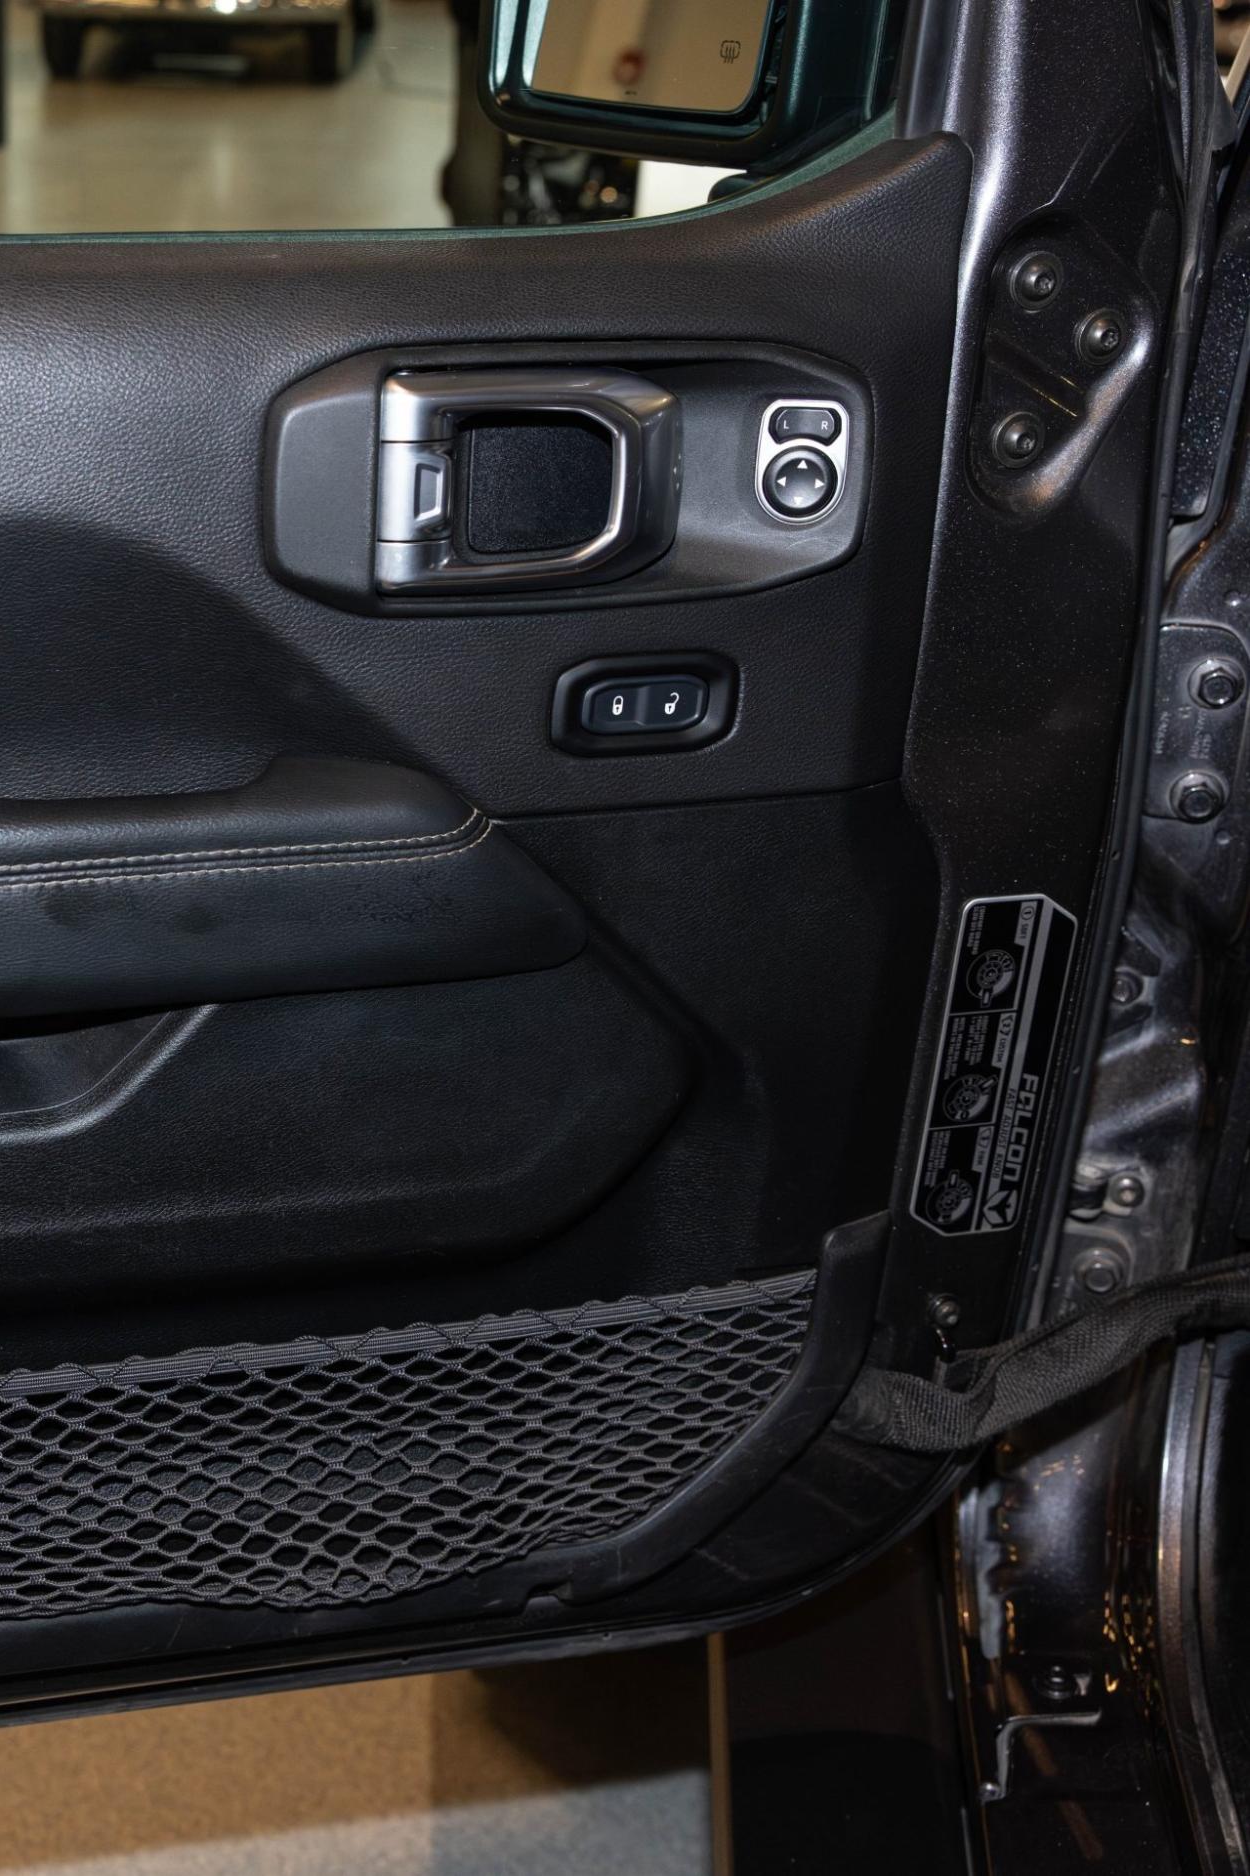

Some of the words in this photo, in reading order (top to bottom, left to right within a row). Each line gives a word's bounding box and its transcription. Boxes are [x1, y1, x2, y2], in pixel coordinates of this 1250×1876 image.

[783, 420, 789, 429] L
[821, 421, 828, 430] R
[1005, 1088, 1016, 1109] FAST
[997, 1114, 1011, 1148] ADJUST
[1002, 1073, 1038, 1181] FALCON
[991, 1152, 1004, 1178] KNOB
